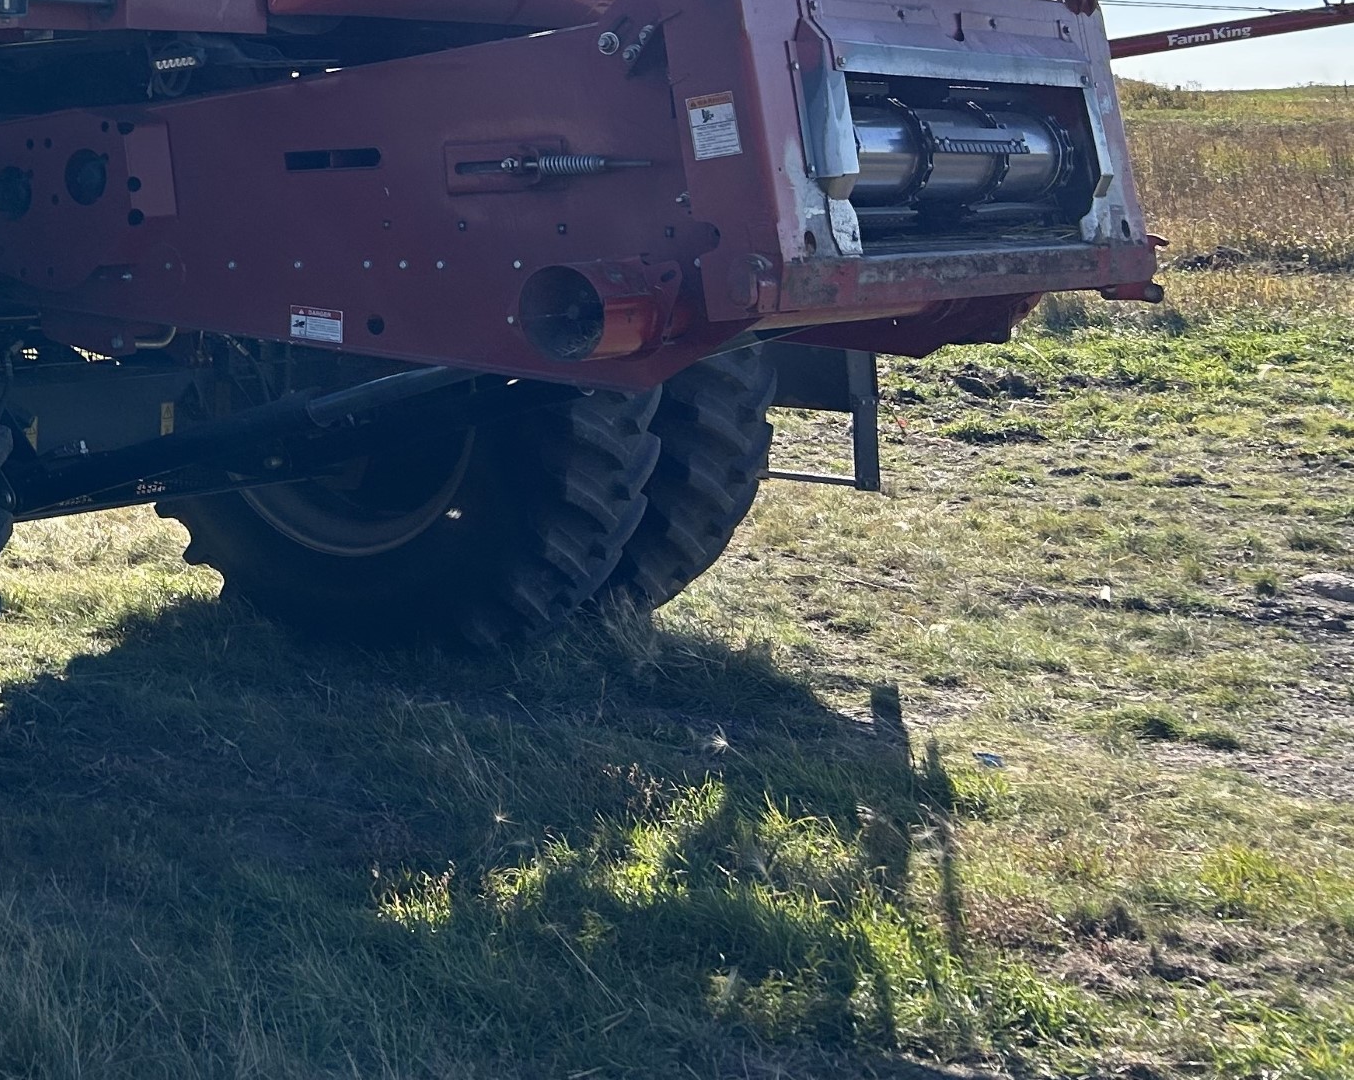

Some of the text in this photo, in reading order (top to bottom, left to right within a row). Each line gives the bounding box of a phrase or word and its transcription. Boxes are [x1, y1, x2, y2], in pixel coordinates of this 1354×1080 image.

[1167, 26, 1252, 47] Farm King
[697, 94, 730, 105] WARNING
[307, 309, 332, 318] DANGER
